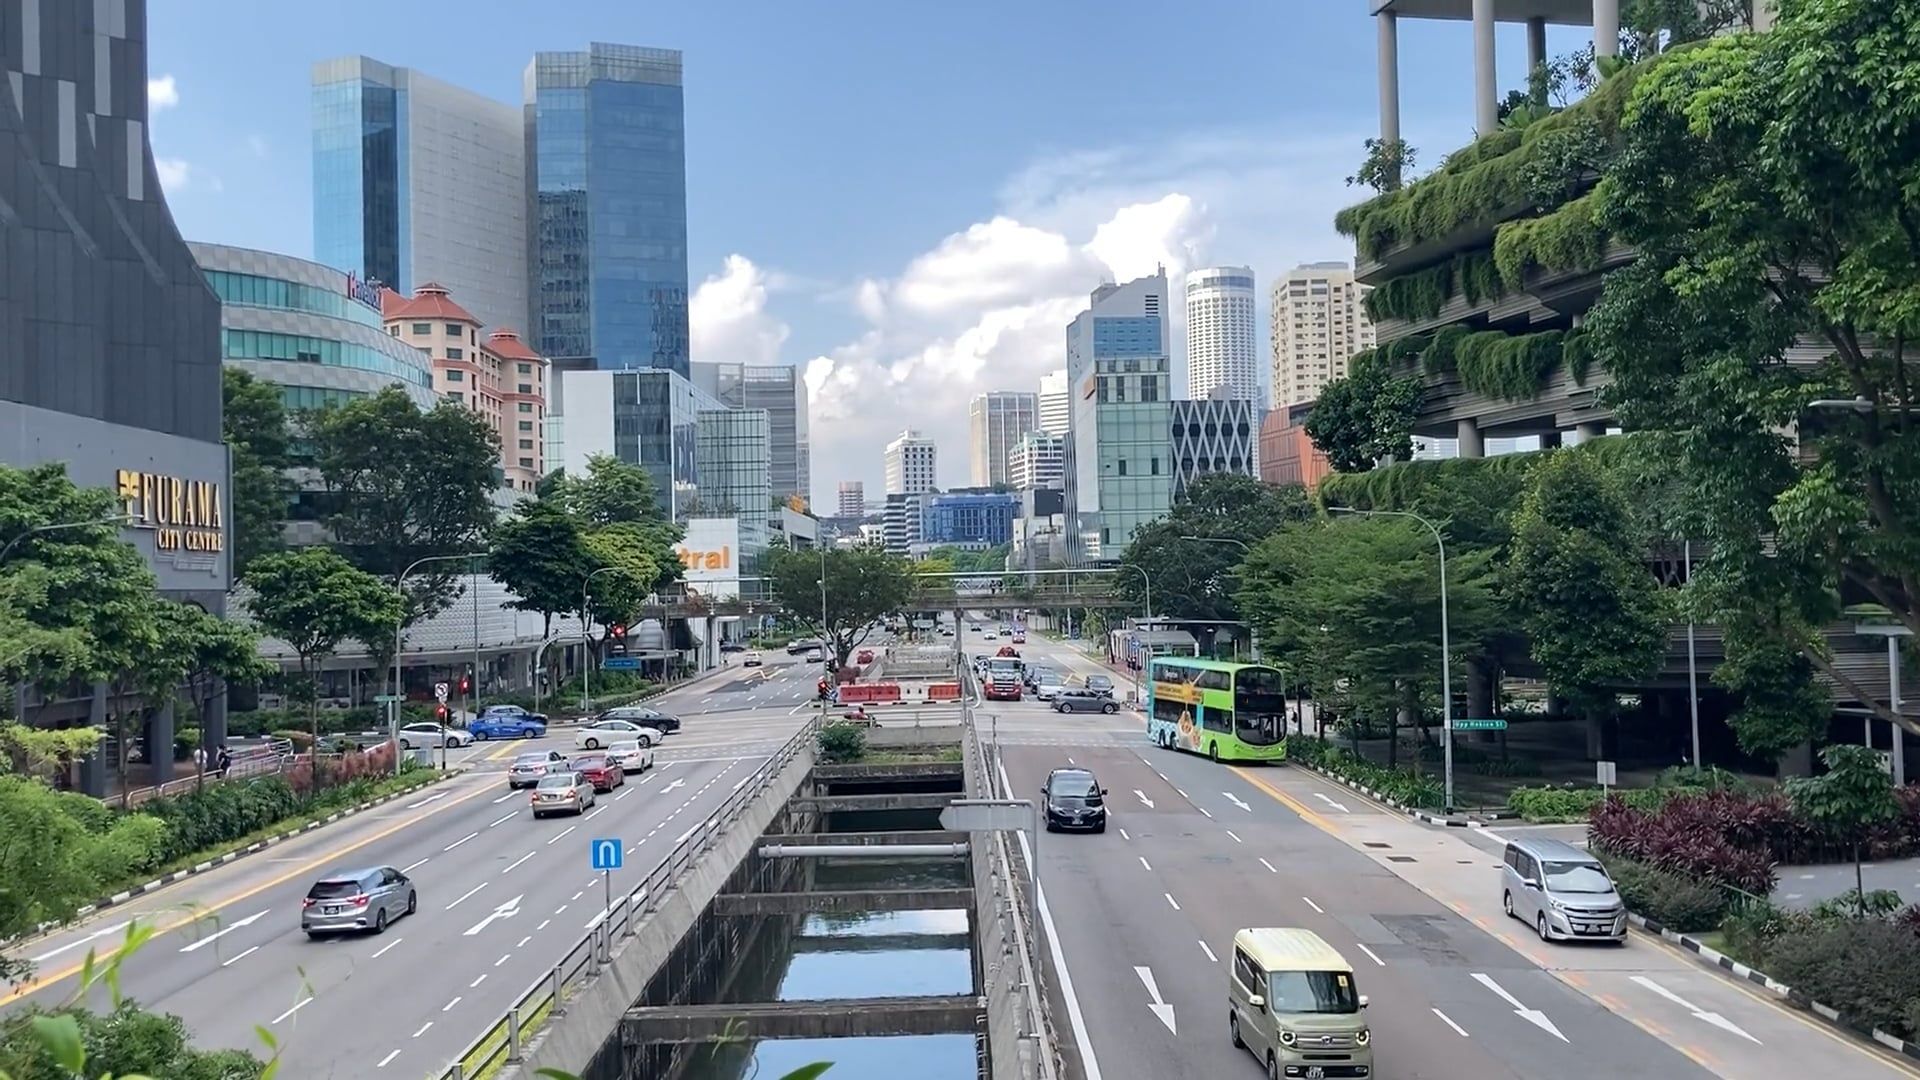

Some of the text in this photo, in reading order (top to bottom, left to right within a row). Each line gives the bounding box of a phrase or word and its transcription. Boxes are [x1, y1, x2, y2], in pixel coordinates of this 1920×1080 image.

[141, 473, 222, 527] FURAMA
[158, 529, 224, 551] CITY CENTRE
